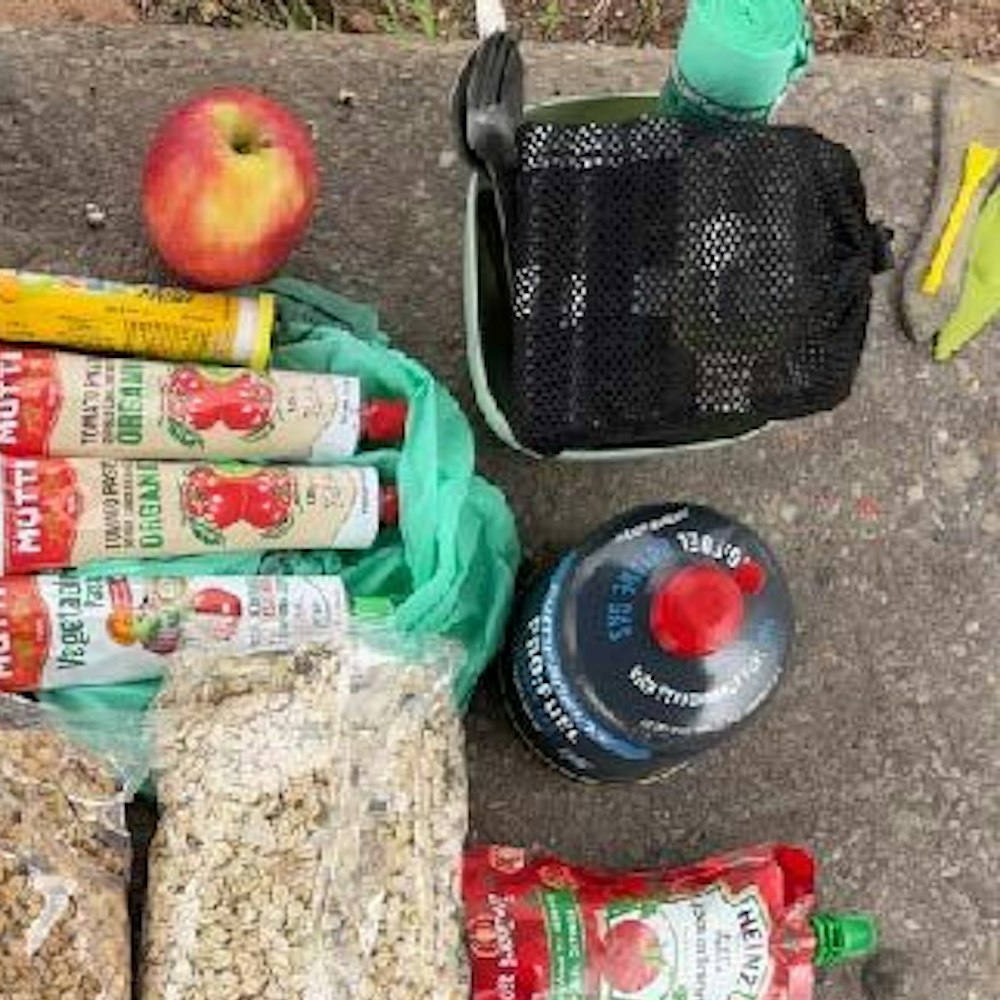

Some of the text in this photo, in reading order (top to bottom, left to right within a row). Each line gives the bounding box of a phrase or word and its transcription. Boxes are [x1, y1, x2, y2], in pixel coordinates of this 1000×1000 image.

[81, 391, 101, 446] TOMATO
[12, 458, 38, 555] MUTTI
[737, 908, 769, 992] HEINZ
